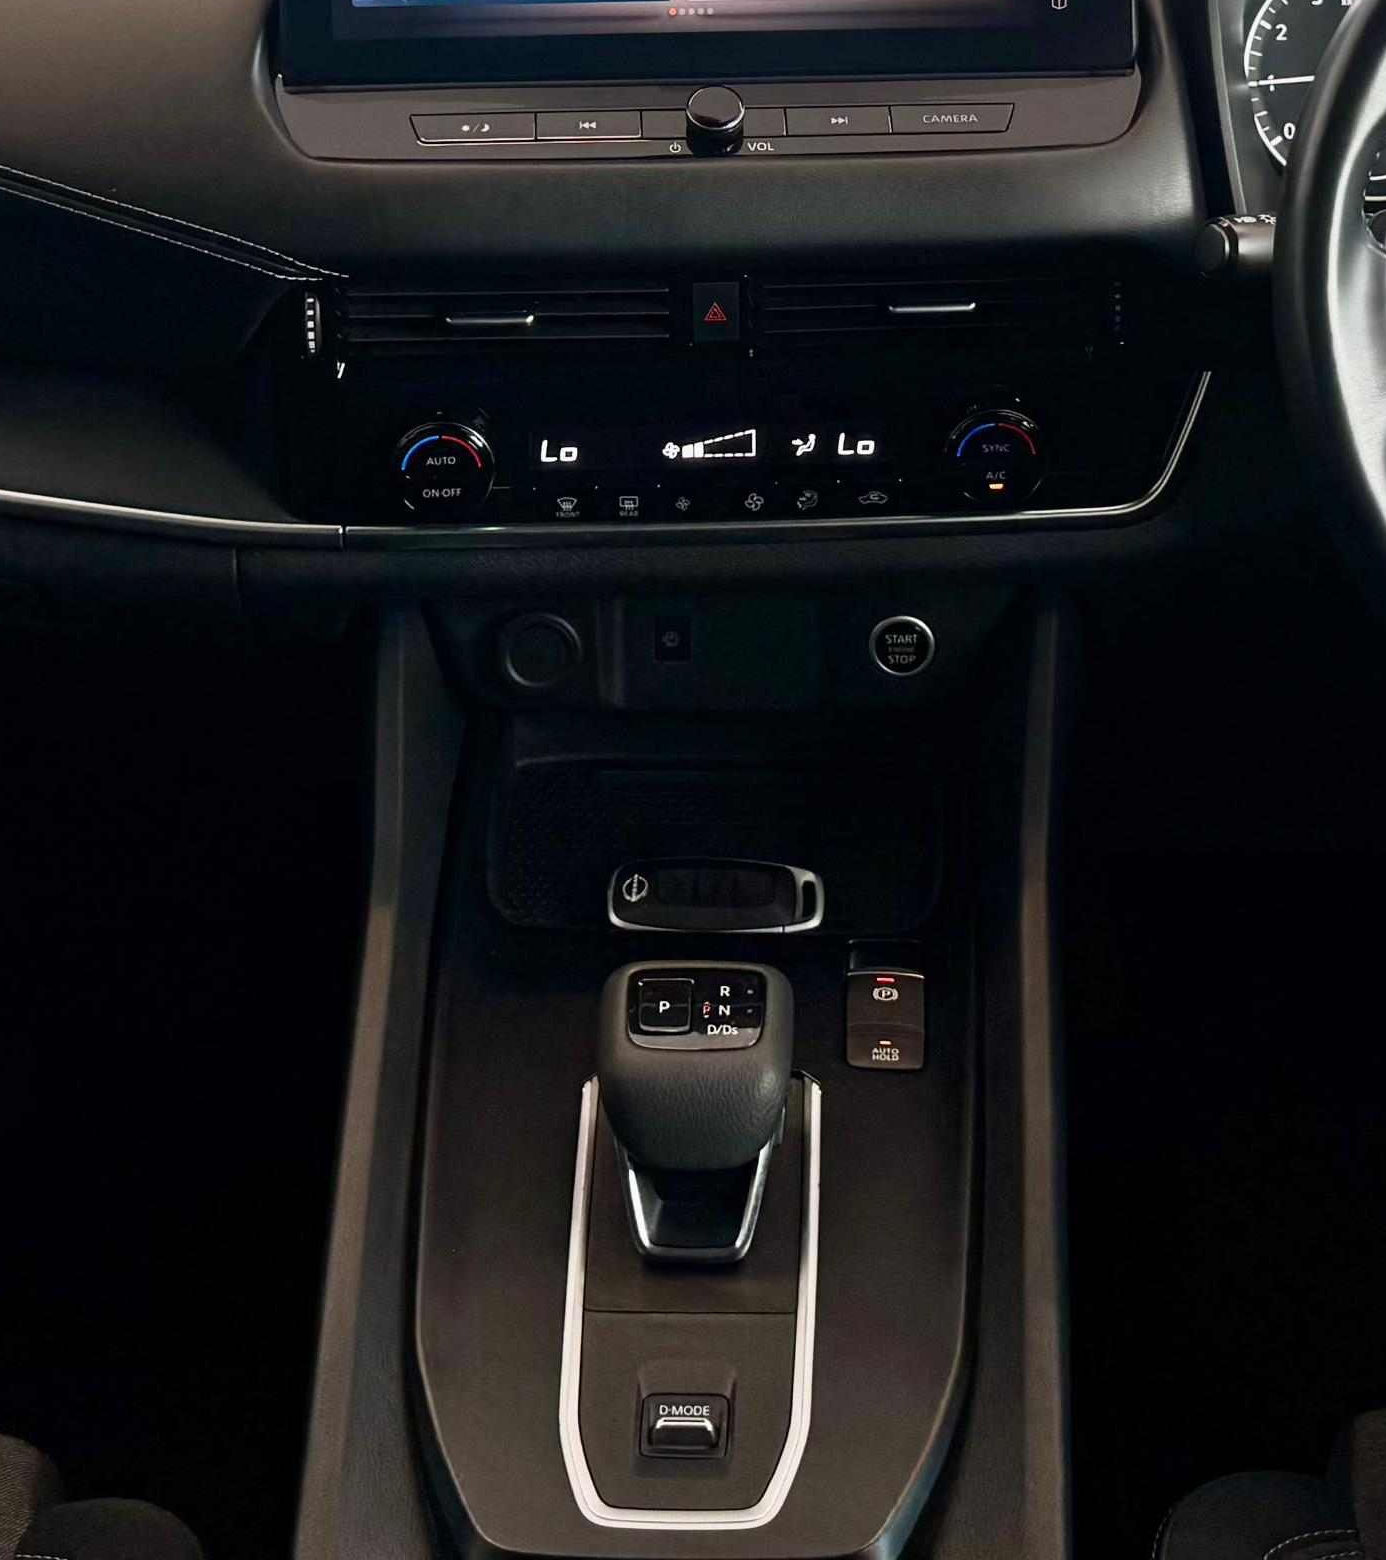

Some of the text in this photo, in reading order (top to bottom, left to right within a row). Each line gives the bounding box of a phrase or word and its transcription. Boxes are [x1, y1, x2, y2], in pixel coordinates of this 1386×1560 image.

[1275, 23, 1288, 41] 2
[922, 112, 979, 125] CAMERA
[1283, 122, 1296, 140] 0
[747, 141, 775, 152] VOL
[837, 432, 876, 456] Lo
[981, 443, 1011, 453] SYNC
[540, 439, 579, 463] Lo
[425, 455, 457, 467] AUTO
[984, 470, 1007, 481] A/C
[884, 633, 917, 645] START
[887, 654, 917, 665] STOP
[719, 985, 731, 997] R
[658, 1000, 671, 1014] P
[718, 1004, 731, 1016] N
[871, 1053, 900, 1061] HOLD
